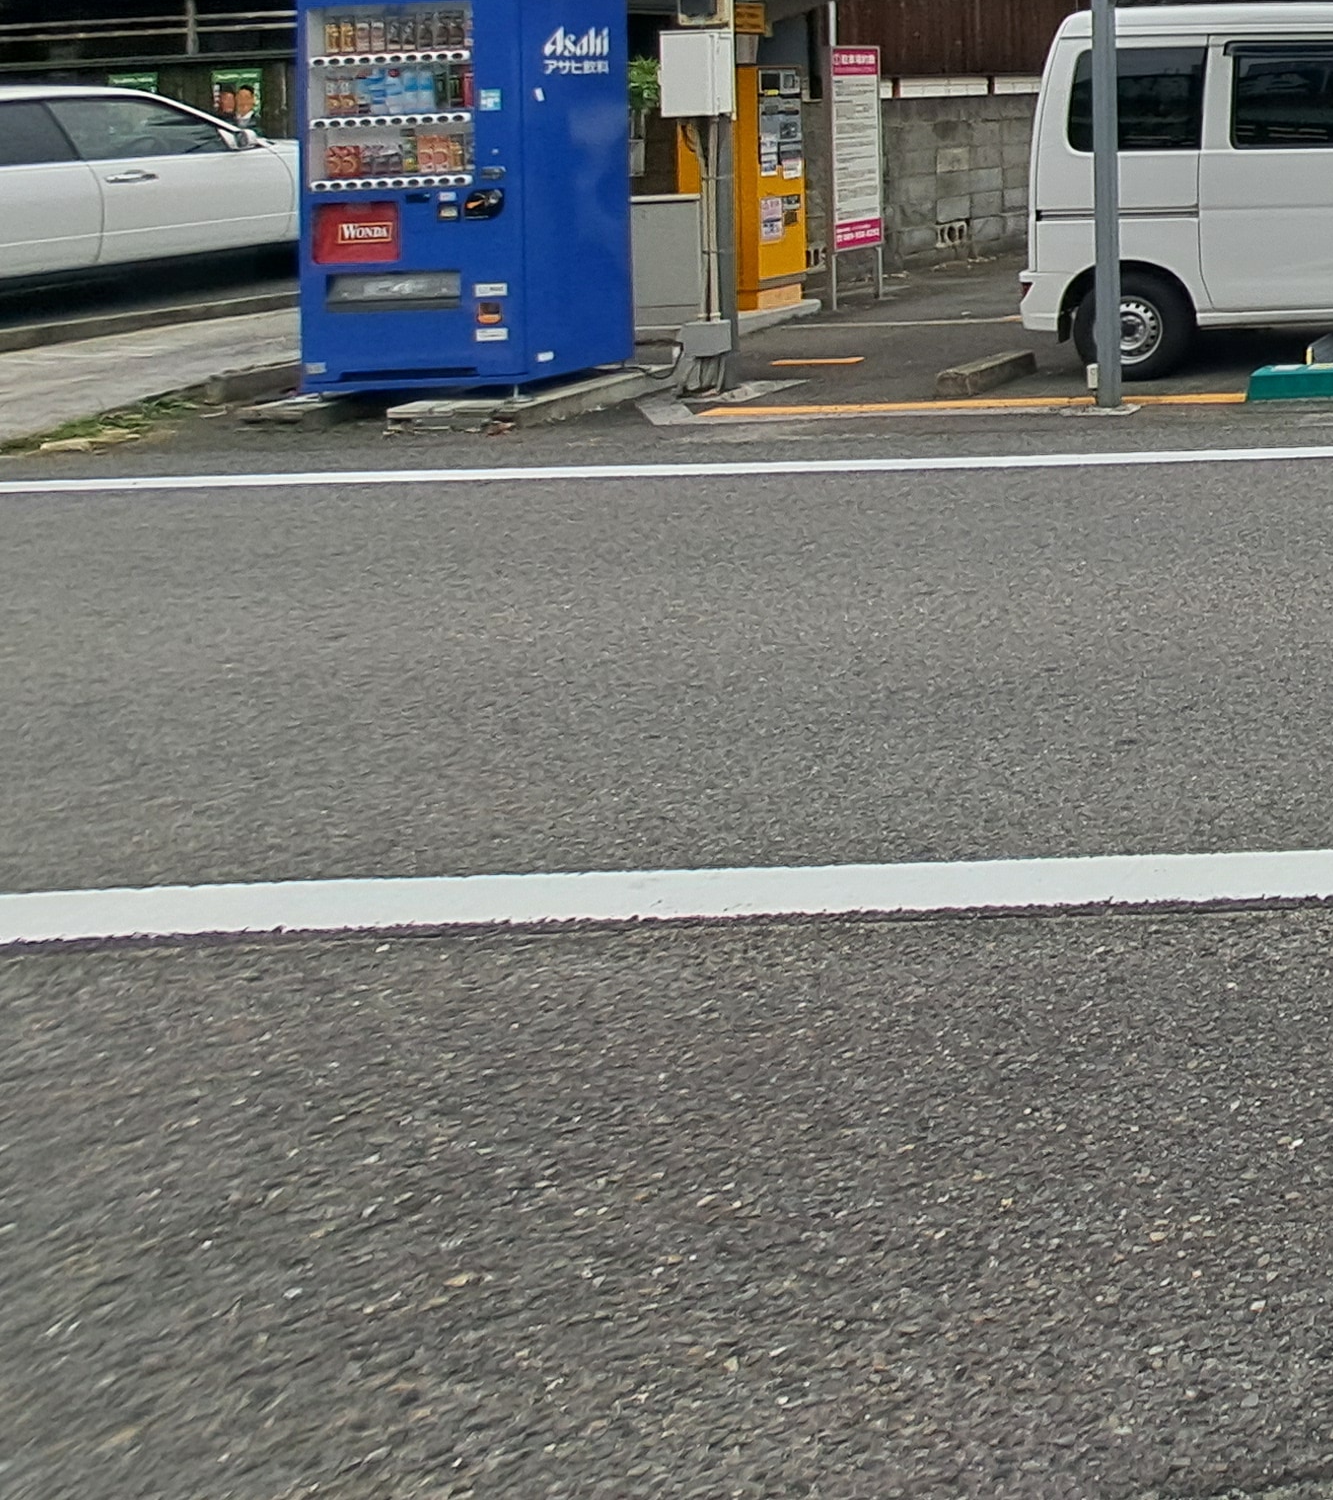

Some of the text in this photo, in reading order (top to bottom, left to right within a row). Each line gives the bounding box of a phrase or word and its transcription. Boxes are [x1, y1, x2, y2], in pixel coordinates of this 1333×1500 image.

[543, 26, 609, 57] Asahi
[543, 59, 609, 75] アサヒ飲料
